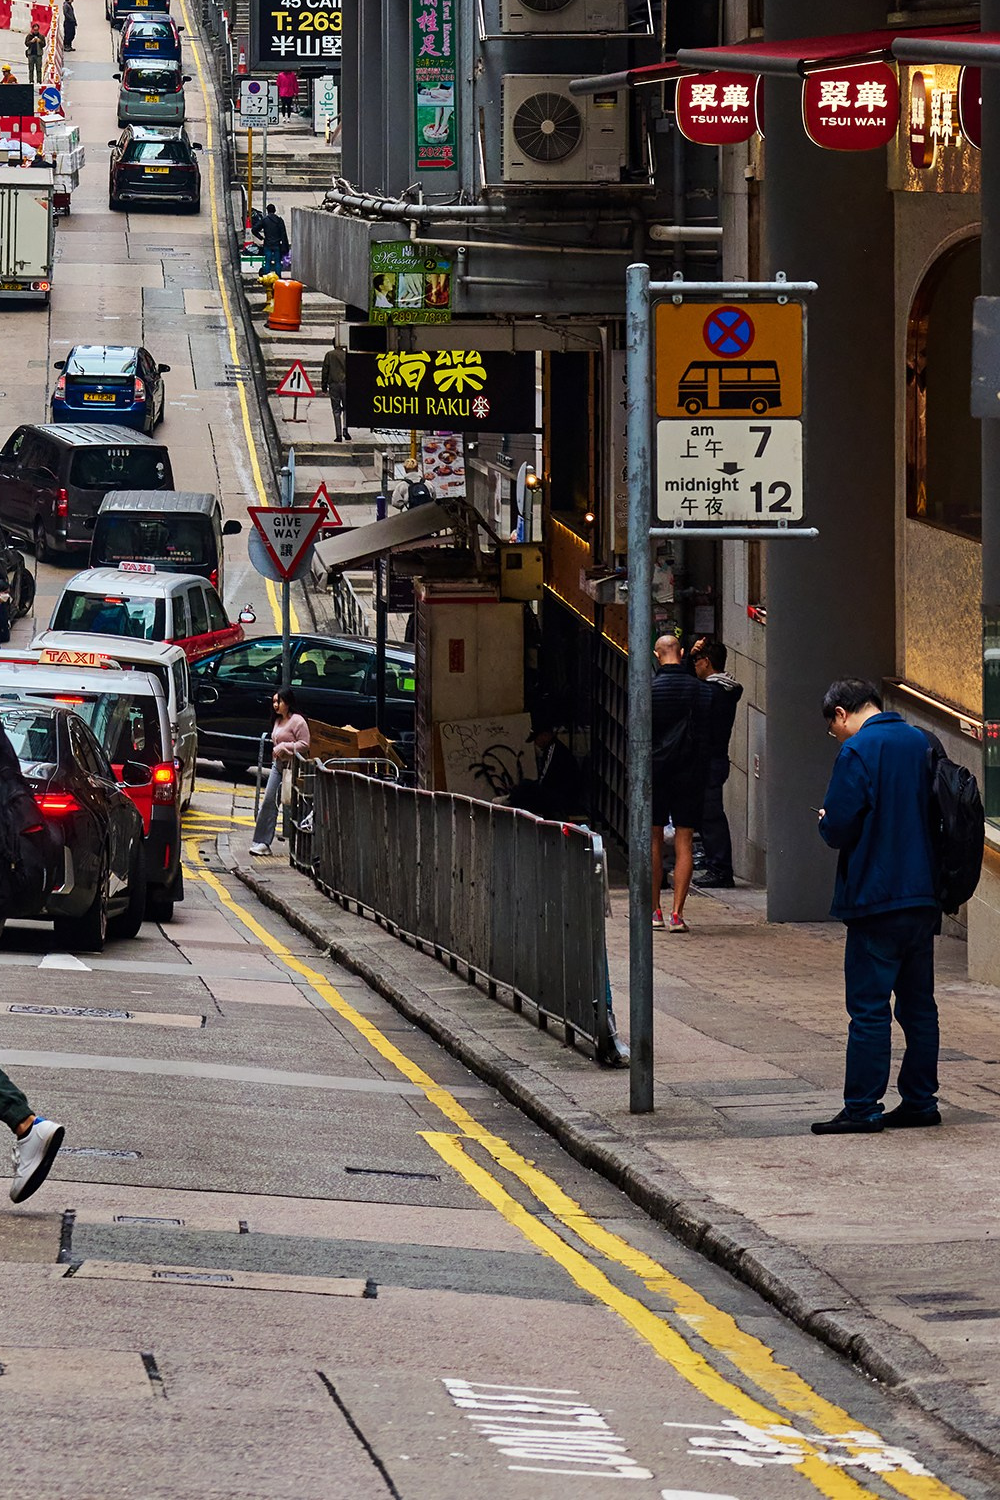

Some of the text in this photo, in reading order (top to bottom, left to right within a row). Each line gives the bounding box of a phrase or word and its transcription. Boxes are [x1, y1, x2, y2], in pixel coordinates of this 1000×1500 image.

[270, 11, 342, 31] T: 263
[688, 83, 750, 113] 翠華
[817, 80, 888, 113] 翠華
[690, 115, 749, 124] TSUI WAH
[819, 116, 887, 126] TSUI WAH
[418, 145, 454, 158] 202室
[392, 311, 418, 322] 2897
[373, 395, 470, 417] SUSHI RAKU
[680, 439, 724, 458] 上午
[690, 425, 772, 458] am 7
[664, 477, 792, 513] midnight 12
[680, 496, 724, 516] 午夜
[273, 517, 301, 527] GIVE
[273, 529, 301, 539] WAY
[280, 543, 293, 557] 讓
[121, 562, 152, 573] TAXI
[45, 650, 96, 665] TAXI
[441, 1378, 655, 1480] LOOK LEFT
